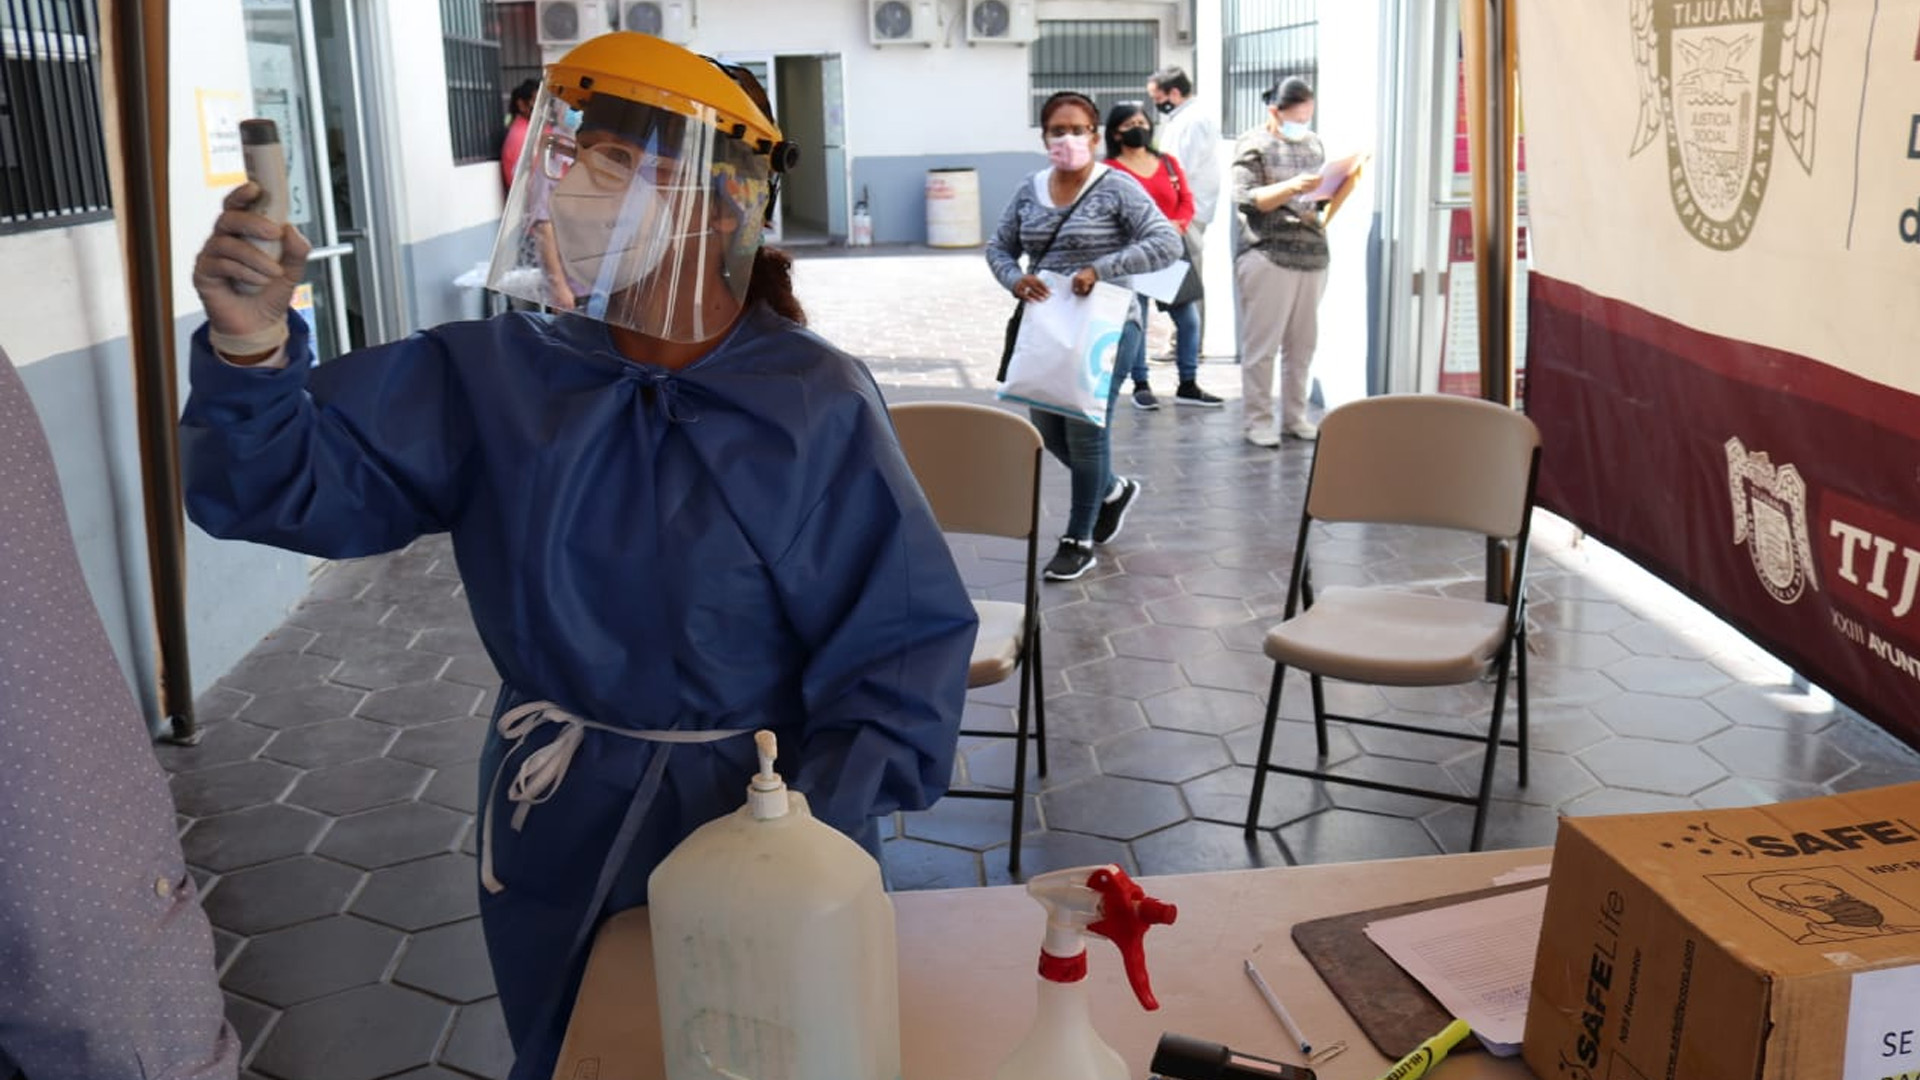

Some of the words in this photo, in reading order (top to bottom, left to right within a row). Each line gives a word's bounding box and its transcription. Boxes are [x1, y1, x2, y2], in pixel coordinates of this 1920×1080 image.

[1674, 1, 1764, 24] TIJUANA
[1735, 209, 1752, 238] LA
[1750, 73, 1776, 198] PATRIA
[1881, 1030, 1914, 1057] SE
